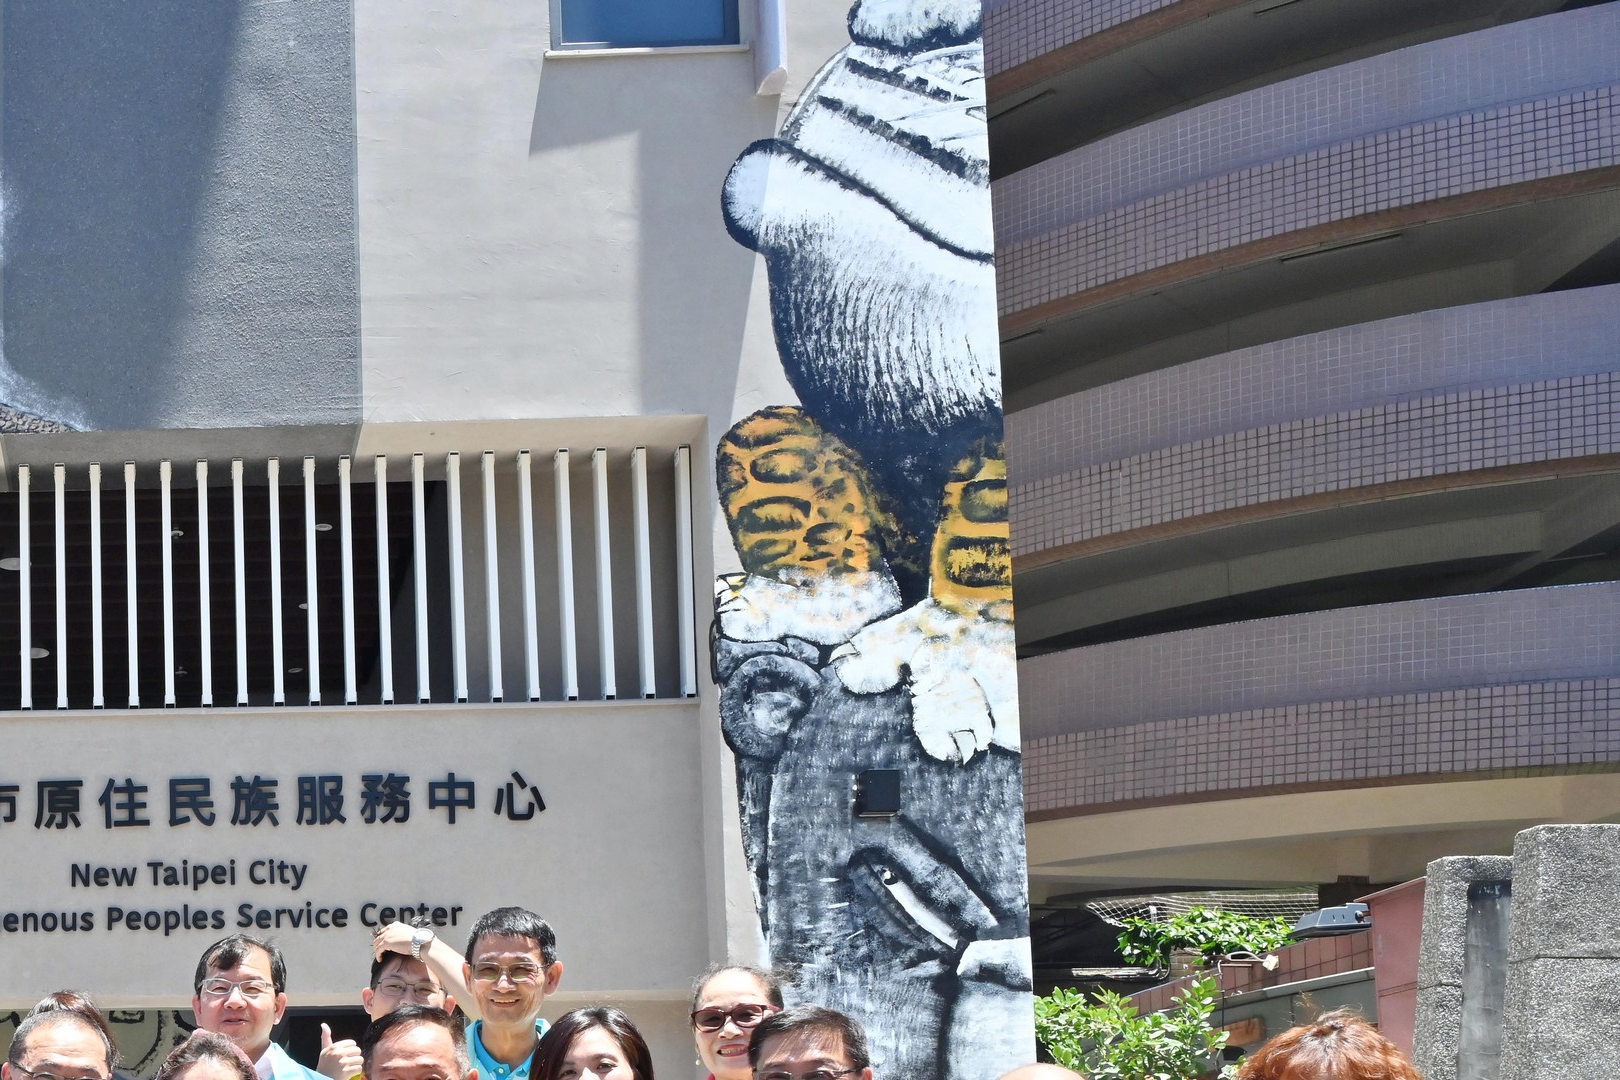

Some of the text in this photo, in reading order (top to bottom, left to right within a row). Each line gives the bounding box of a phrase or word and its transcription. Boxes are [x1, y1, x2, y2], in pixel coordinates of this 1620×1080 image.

[71, 858, 308, 891] New Taipei City
[107, 903, 227, 937] Peoples
[236, 900, 349, 930] Service
